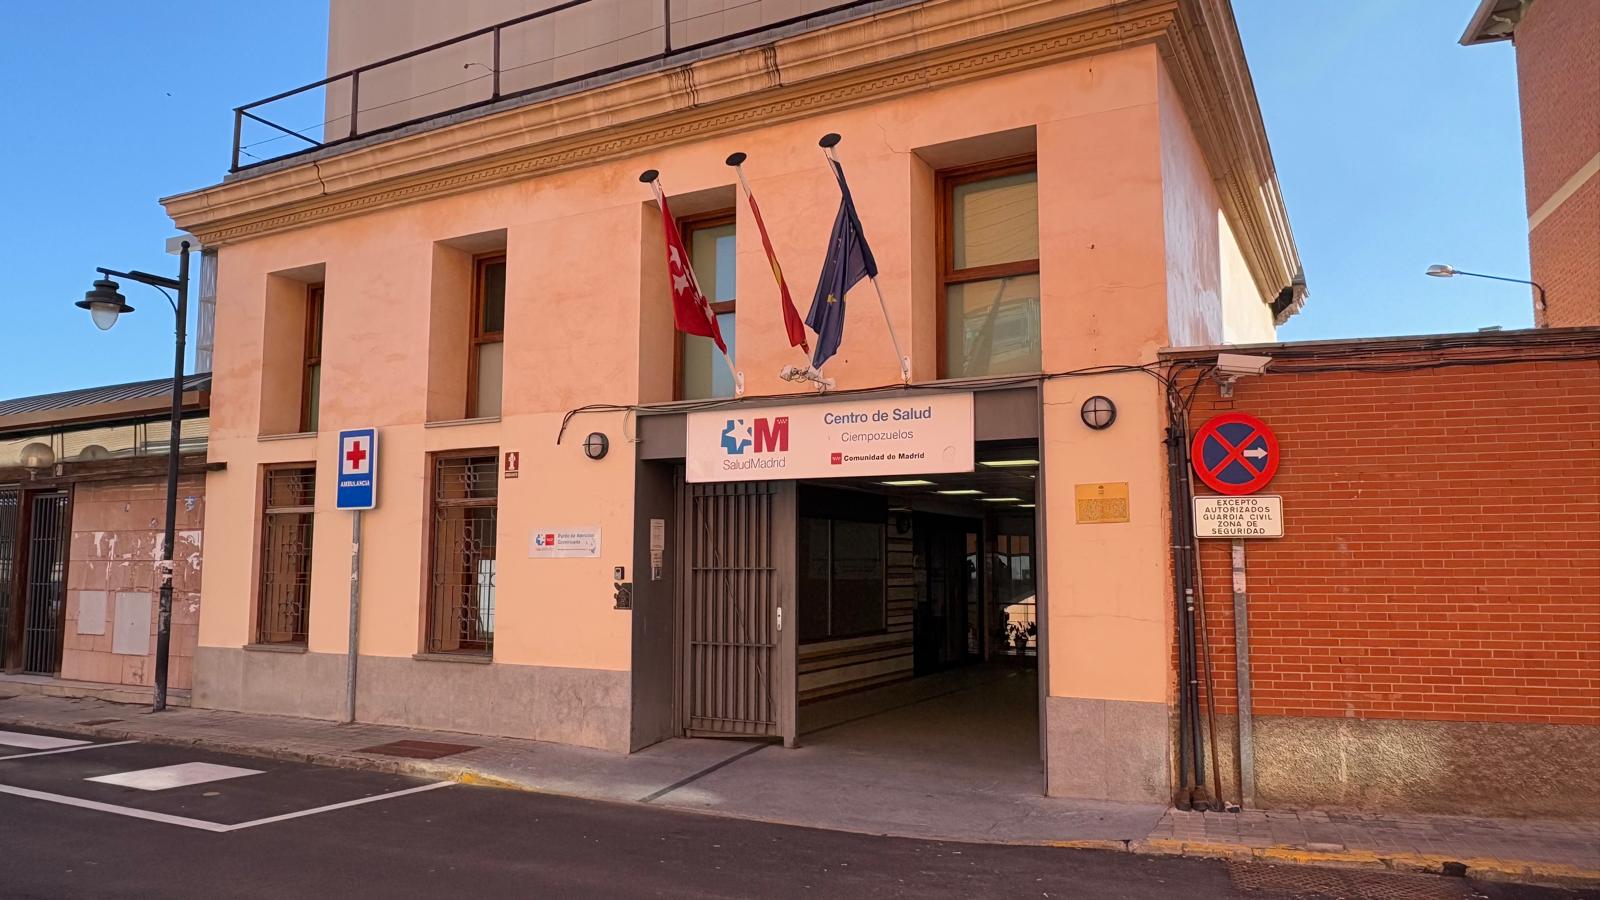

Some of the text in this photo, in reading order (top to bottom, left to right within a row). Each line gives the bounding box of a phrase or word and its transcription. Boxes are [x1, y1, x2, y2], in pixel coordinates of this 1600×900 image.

[824, 406, 932, 426] Centro de Salud
[841, 429, 914, 443] Ciempozuelos
[843, 451, 925, 462] Comunidad de Madrid
[723, 457, 786, 471] SaludMadrid
